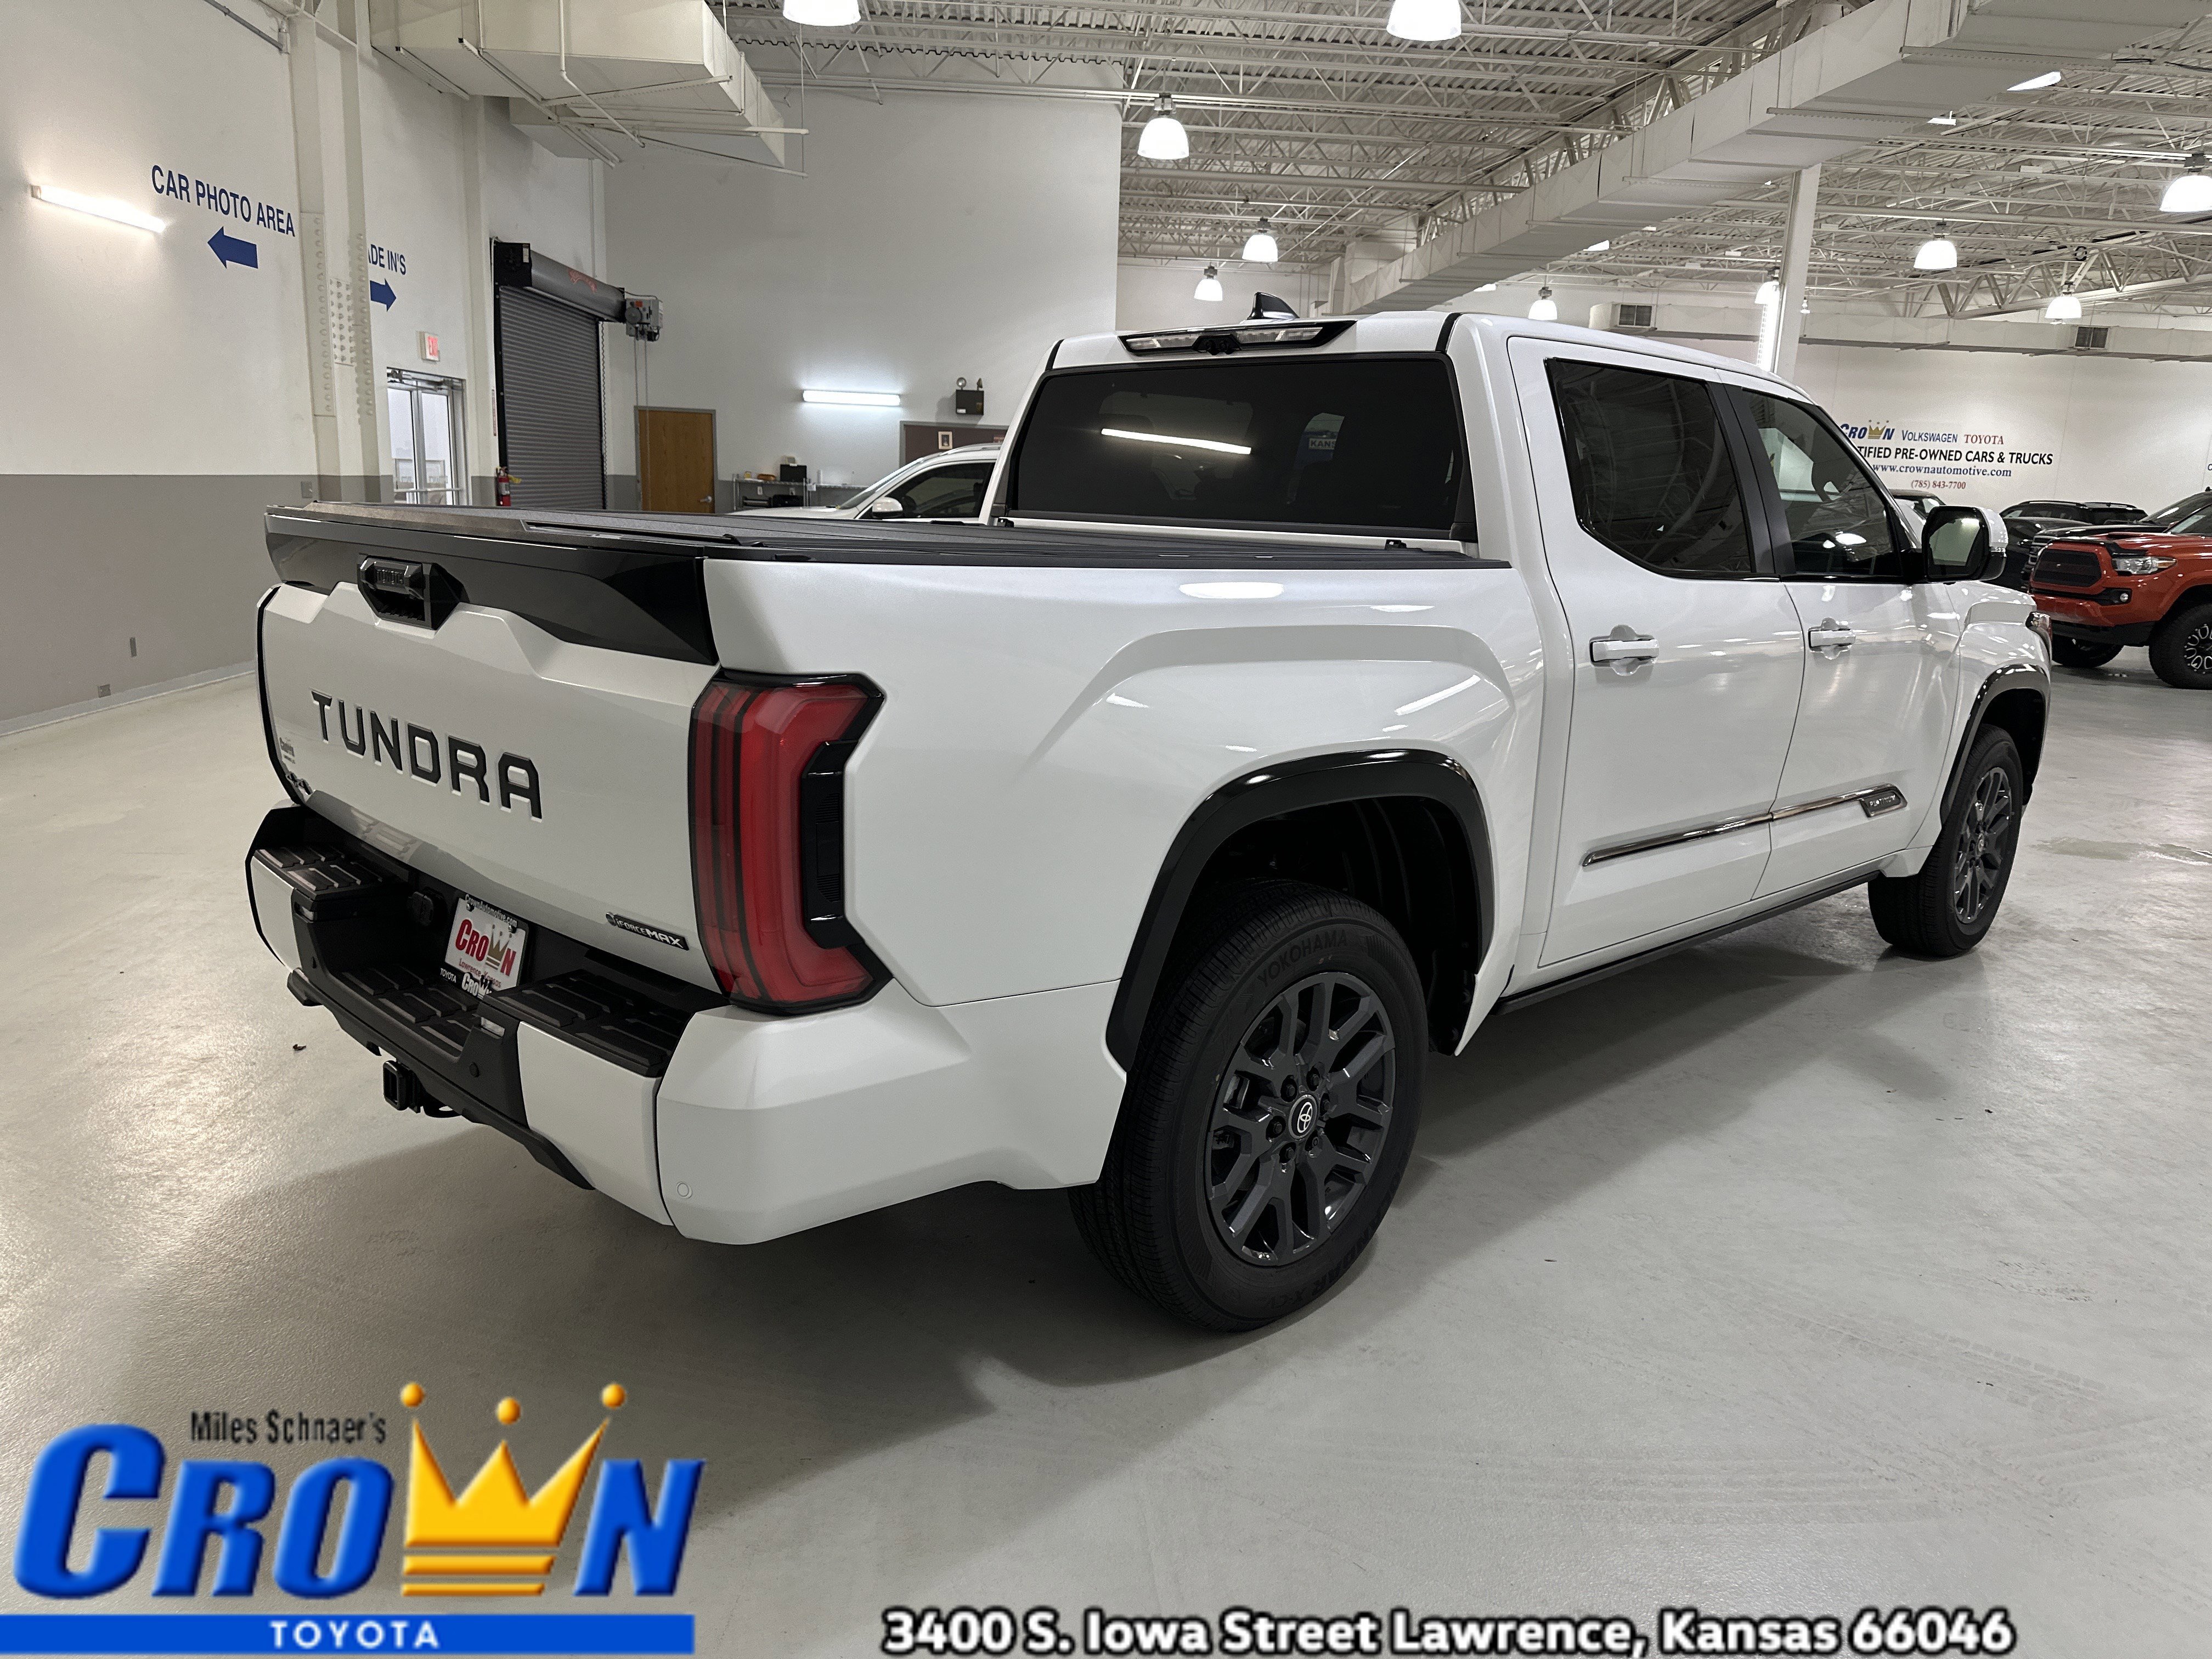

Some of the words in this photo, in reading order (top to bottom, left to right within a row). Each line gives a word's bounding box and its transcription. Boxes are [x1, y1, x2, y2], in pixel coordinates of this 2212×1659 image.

[151, 165, 190, 203] CAR
[195, 179, 251, 222] PHOTO
[256, 202, 295, 237] AREA
[387, 250, 406, 275] IN'S
[1901, 430, 1958, 443] VOLKSWAGEN
[1964, 434, 2004, 445] TOYOTA
[1894, 448, 1962, 461] PRE-OWNED
[1965, 450, 1995, 463] CARS
[1997, 452, 2006, 463] &
[2008, 452, 2053, 465] TRUCKS
[1872, 465, 2012, 477] www.crownautomotive.com
[1911, 479, 1931, 489] (785)
[1932, 481, 1966, 489] 843-7700
[311, 690, 543, 821] TUNDRA
[455, 919, 516, 977] CROWN
[1257, 929, 1348, 987] YOKOHAMA
[440, 968, 457, 983] TOYOTA
